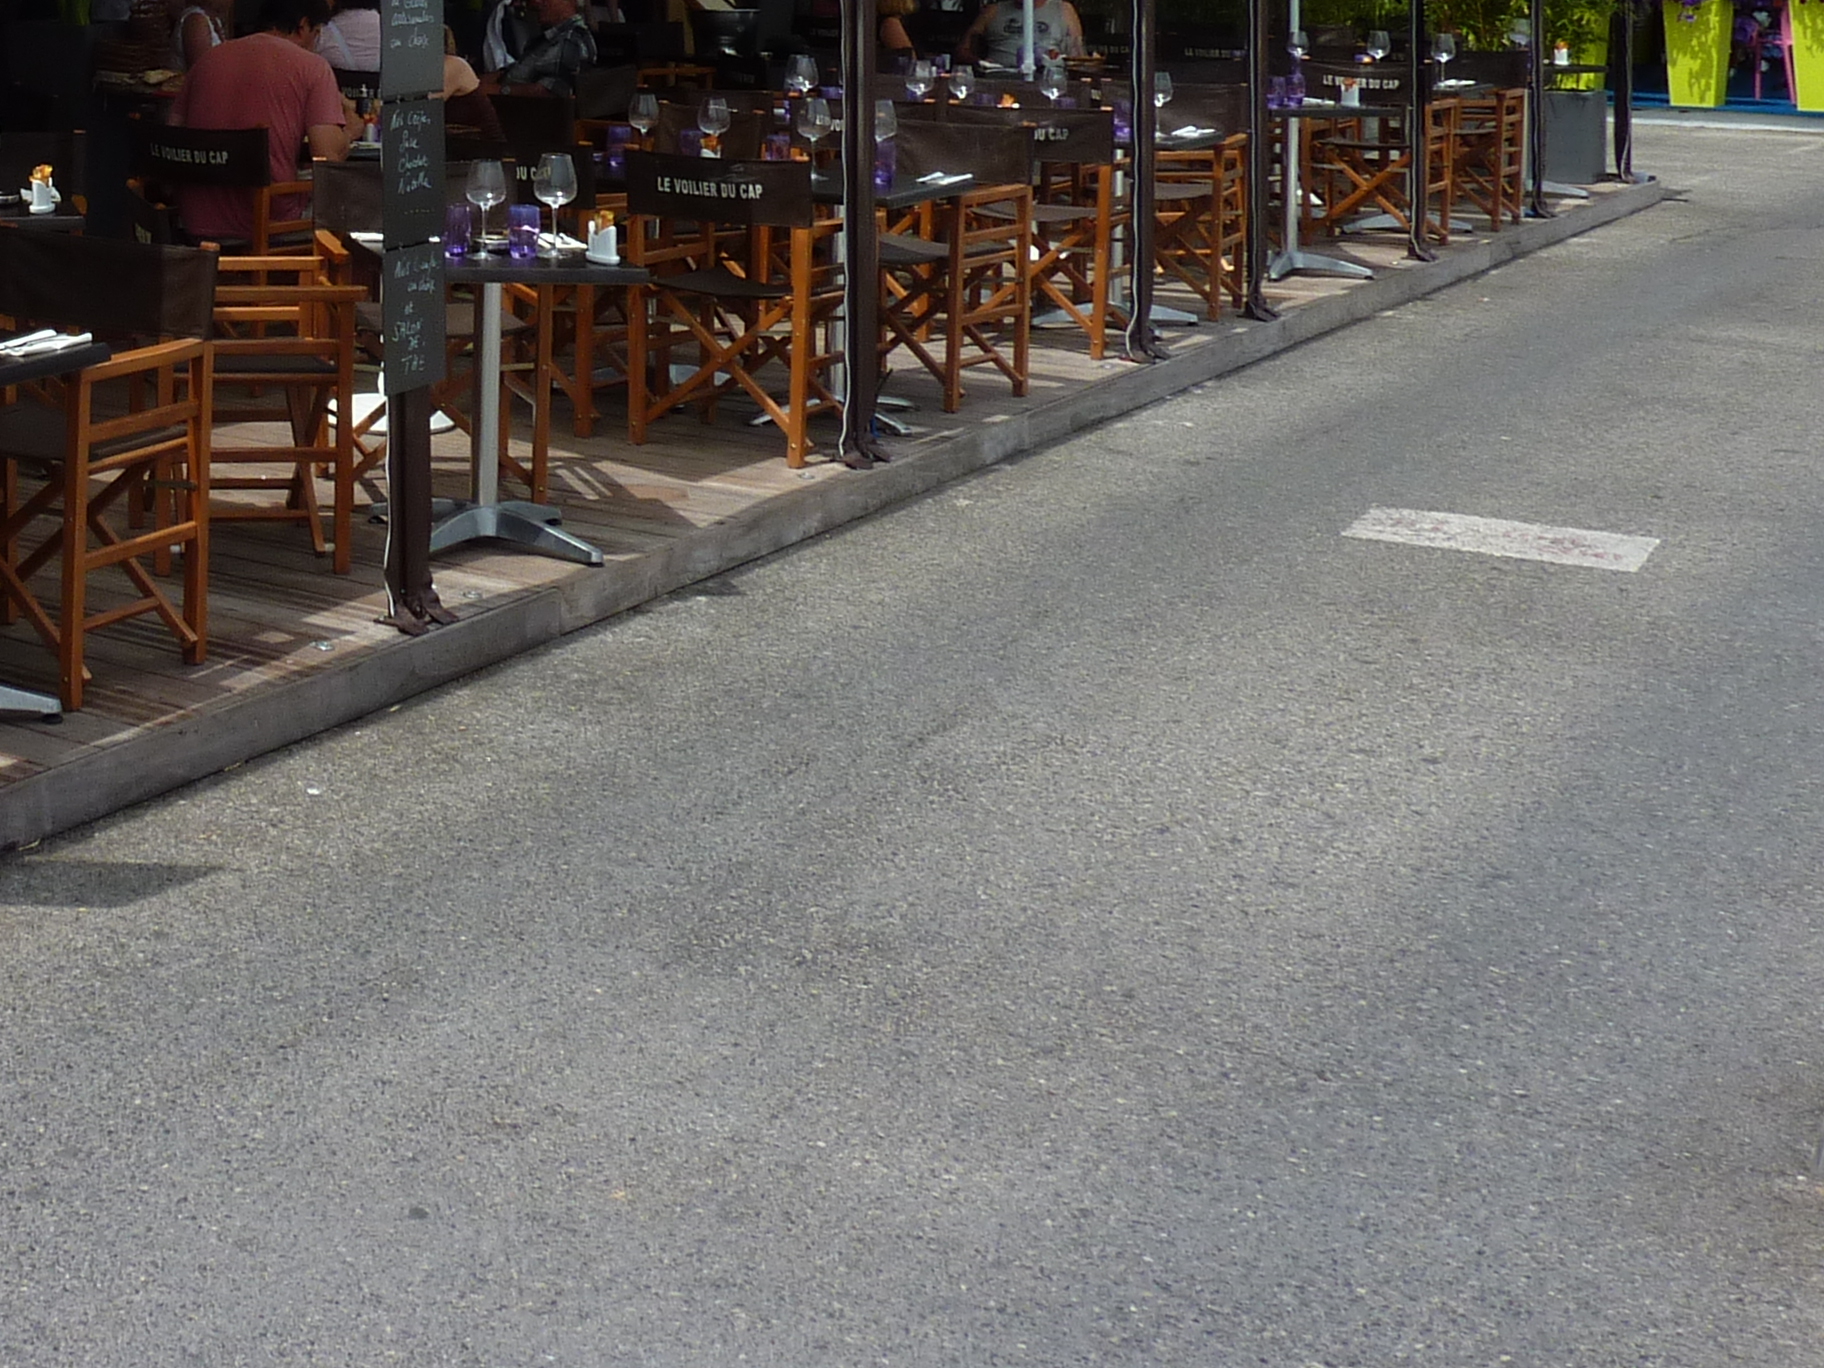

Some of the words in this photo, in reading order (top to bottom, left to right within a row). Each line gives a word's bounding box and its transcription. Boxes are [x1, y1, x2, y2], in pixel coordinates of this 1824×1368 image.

[161, 145, 193, 163] VOILIER
[194, 150, 207, 164] DU
[209, 150, 229, 165] CAP
[657, 176, 671, 193] LE
[674, 178, 718, 198] VOILIER
[721, 183, 736, 199] DU
[739, 184, 764, 200] CAP
